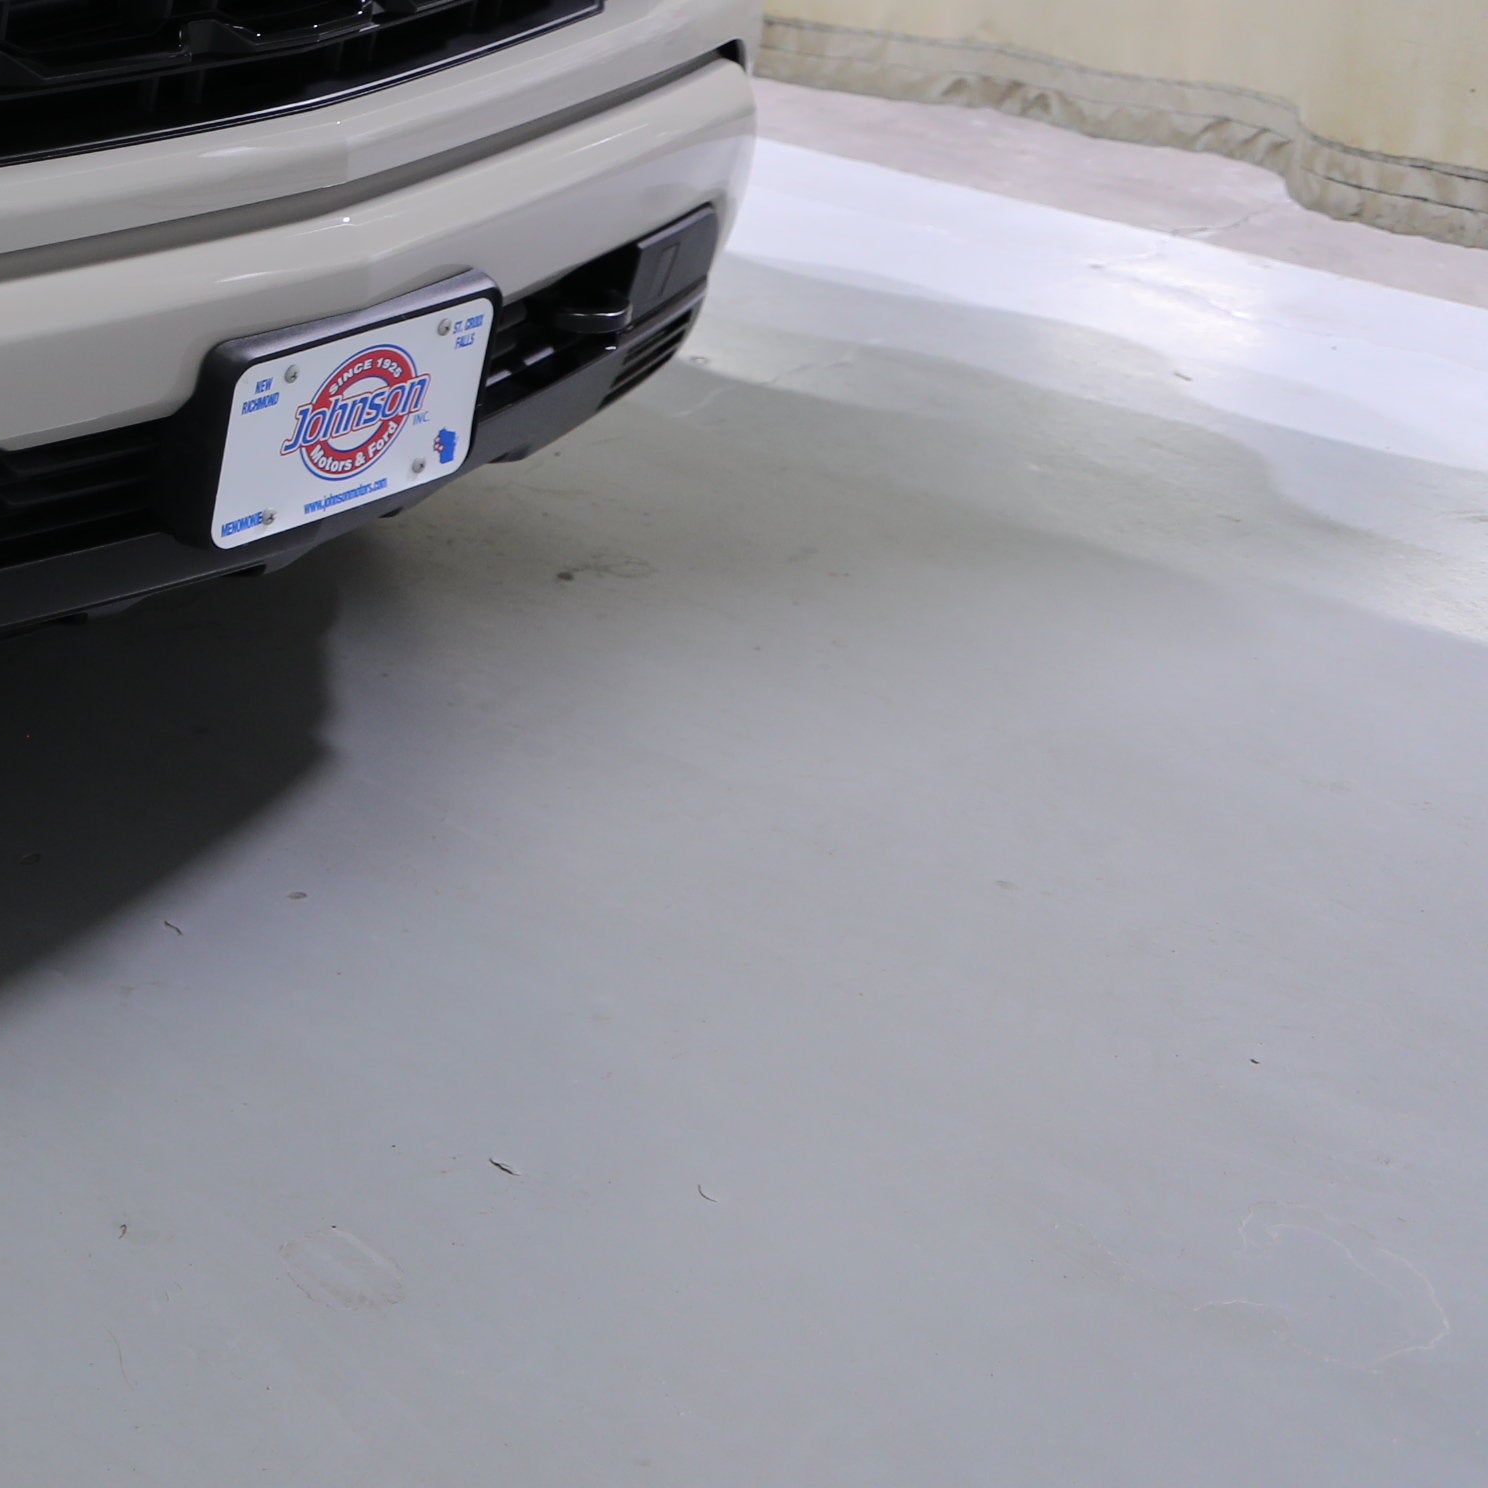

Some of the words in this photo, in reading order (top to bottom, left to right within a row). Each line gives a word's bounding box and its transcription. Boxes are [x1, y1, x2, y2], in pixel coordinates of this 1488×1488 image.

[329, 359, 373, 395] SINCE
[377, 358, 403, 378] 1925
[283, 377, 427, 452] Johnson
[310, 445, 353, 472] Motors
[355, 451, 366, 467] &
[368, 421, 399, 457] Ford
